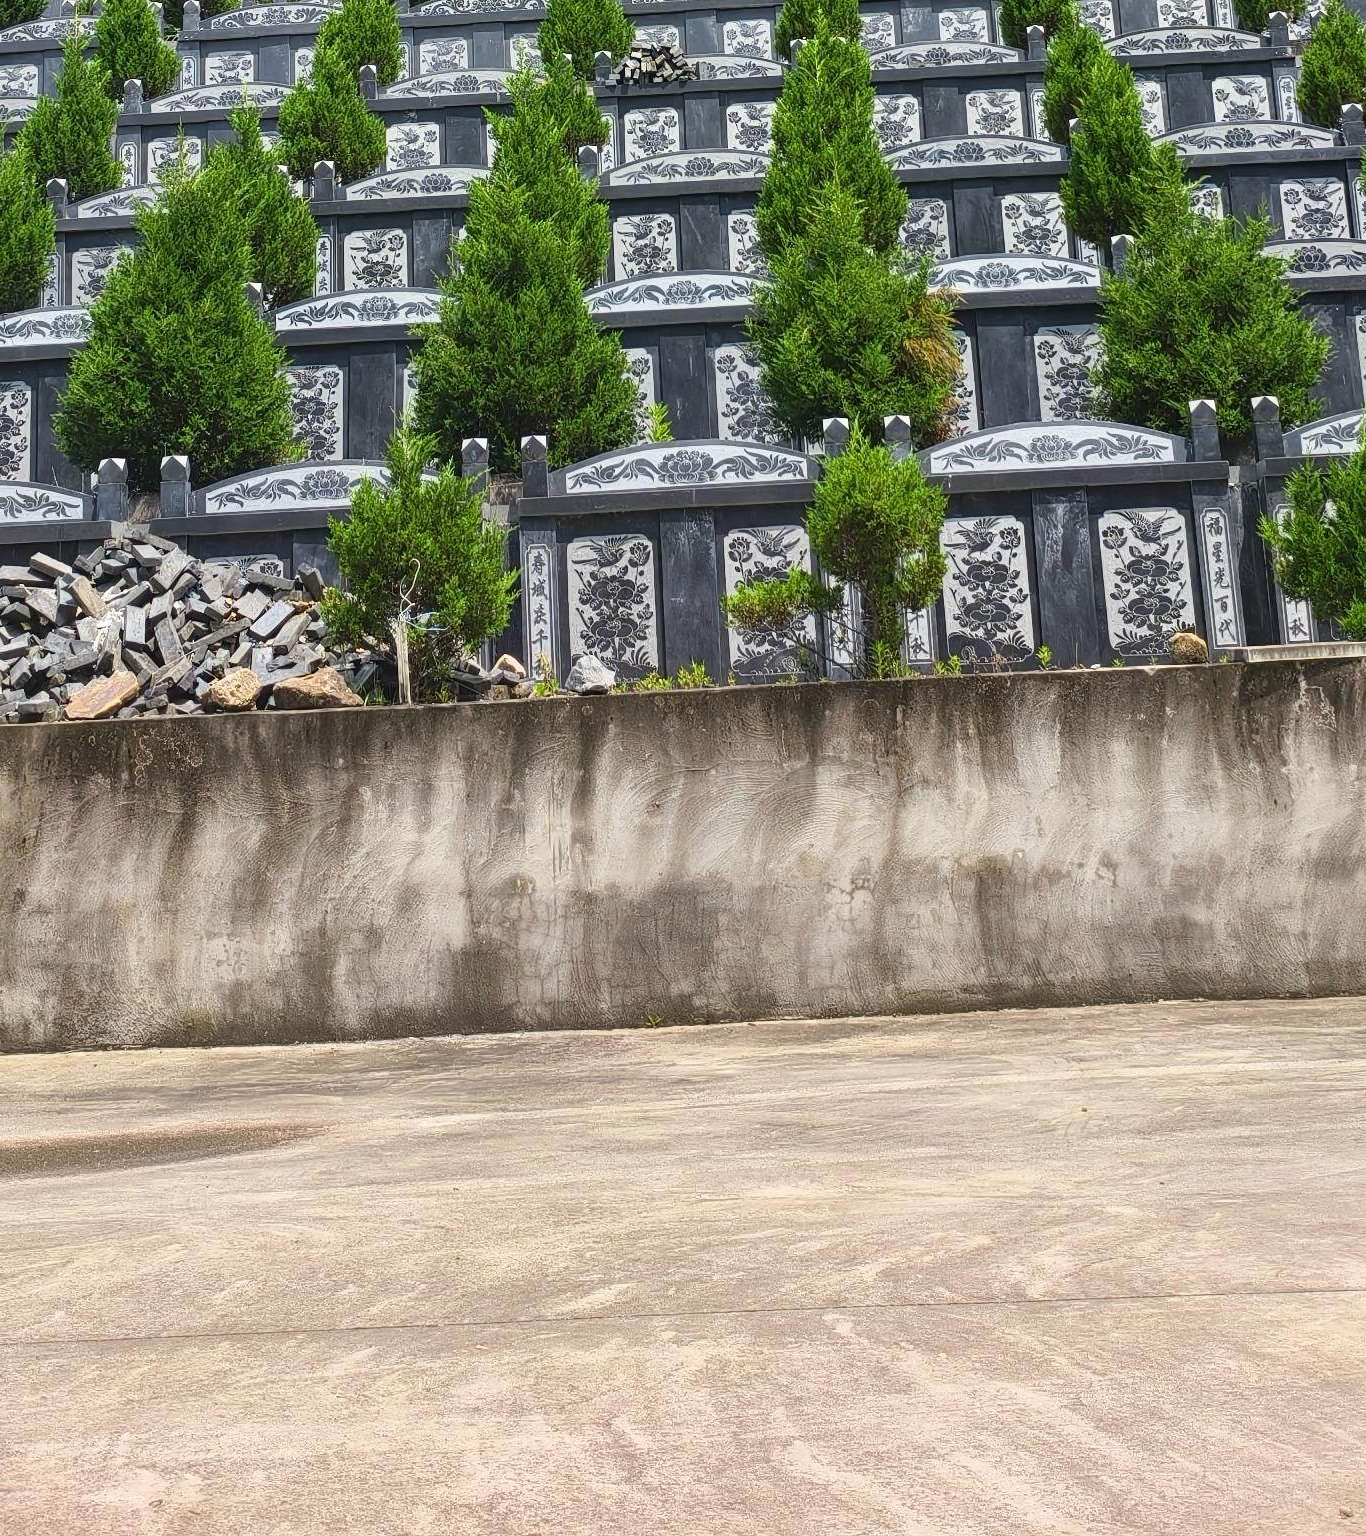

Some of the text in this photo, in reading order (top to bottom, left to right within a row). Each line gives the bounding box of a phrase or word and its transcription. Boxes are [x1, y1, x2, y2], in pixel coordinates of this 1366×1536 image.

[1206, 515, 1237, 644] 福星光百代
